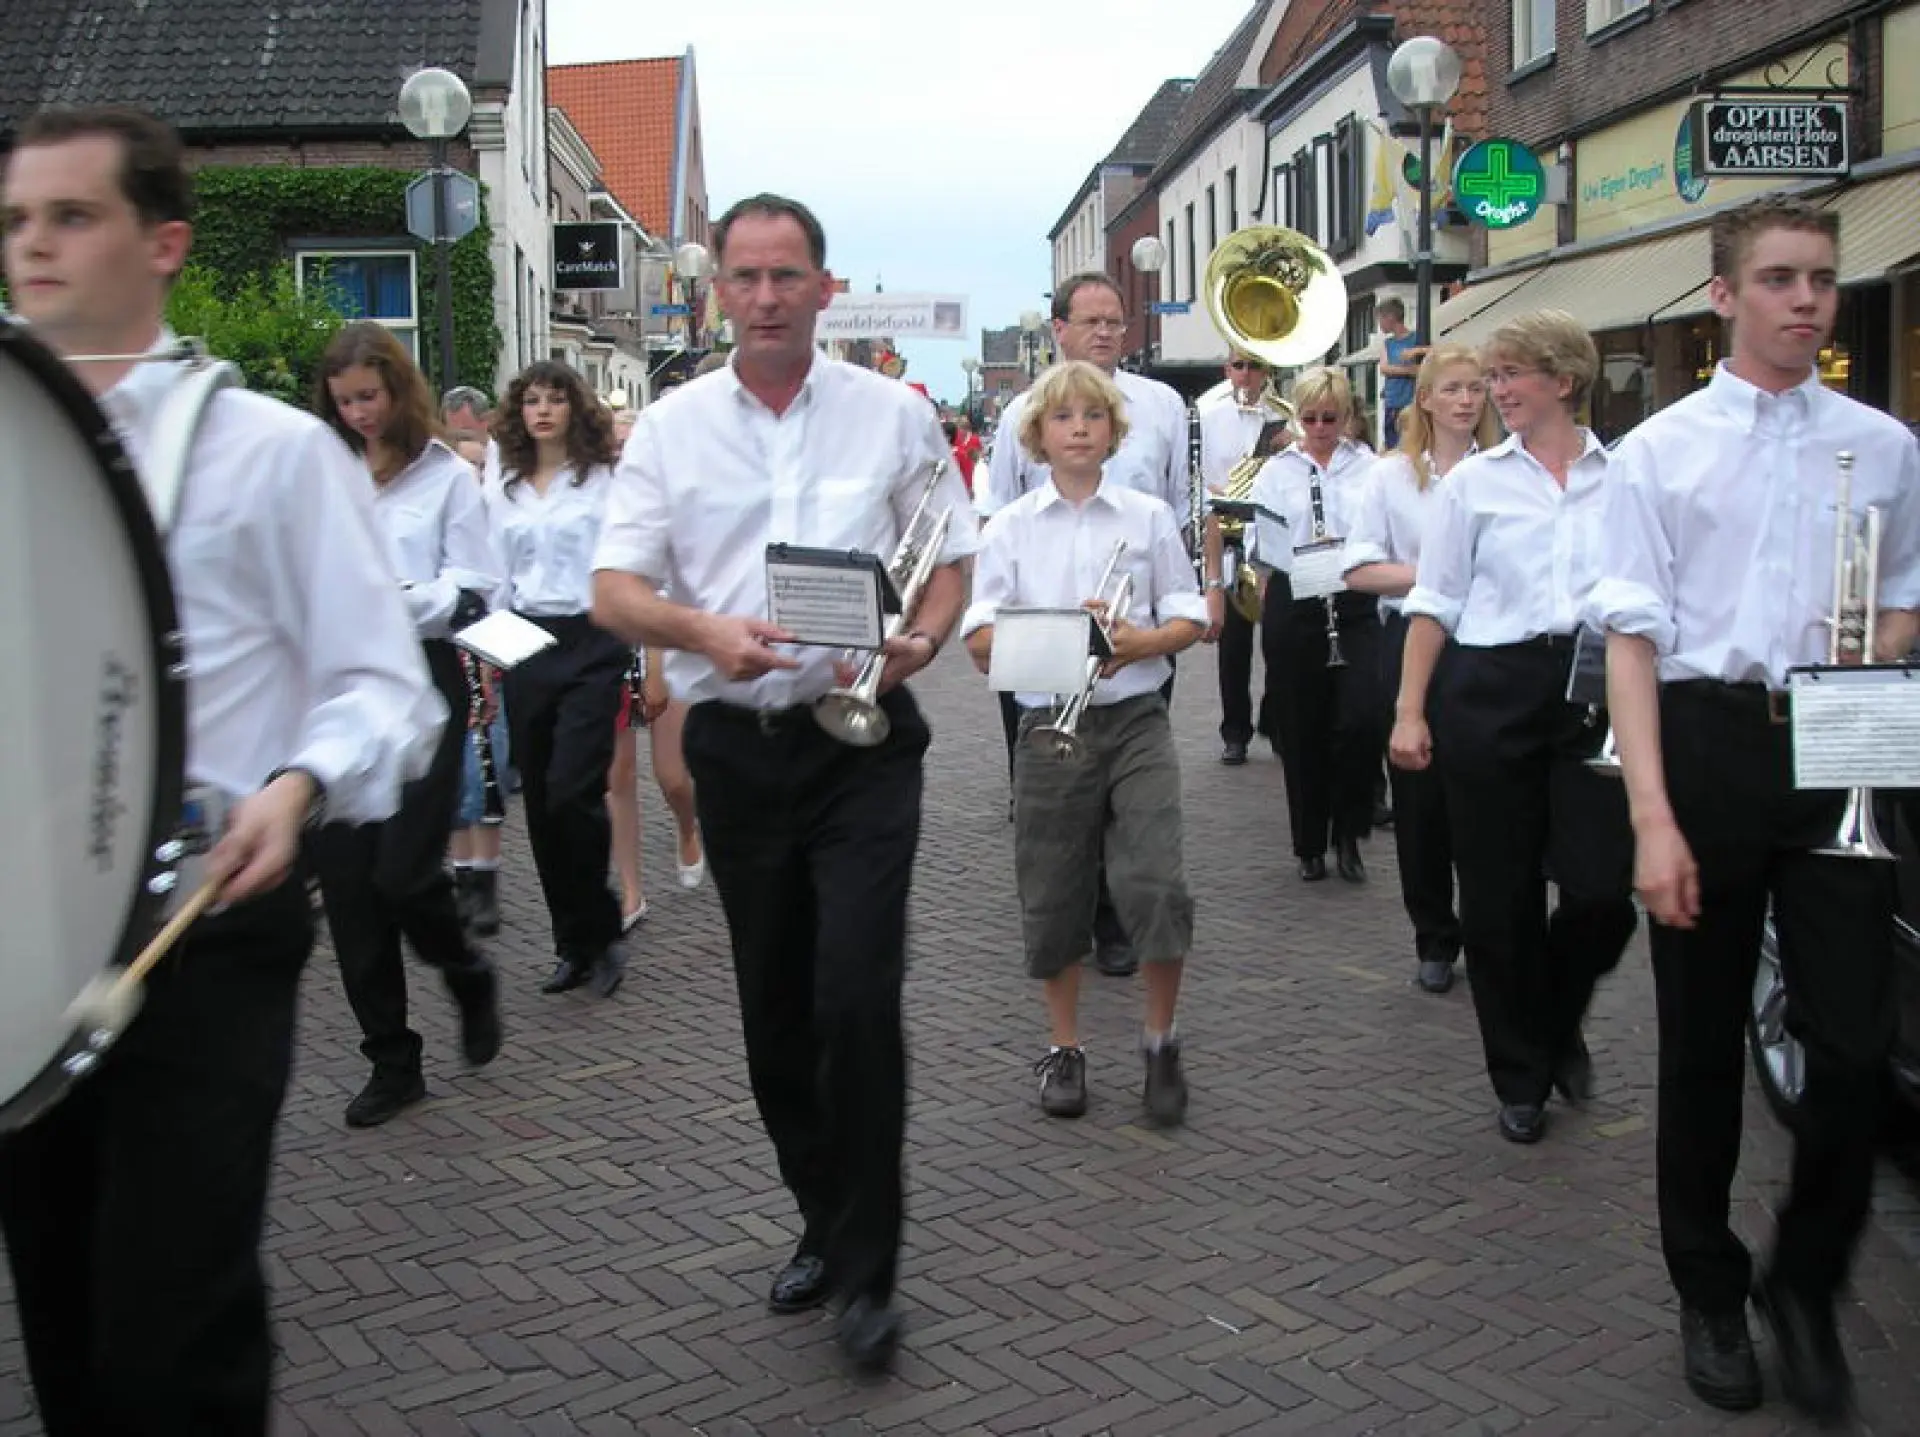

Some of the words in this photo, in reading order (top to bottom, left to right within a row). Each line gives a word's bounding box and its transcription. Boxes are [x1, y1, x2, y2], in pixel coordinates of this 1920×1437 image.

[1727, 106, 1823, 128] OPTIEK
[1723, 145, 1830, 167] AARSEN
[1475, 200, 1529, 223] Drogist
[556, 259, 618, 273] CareMatch
